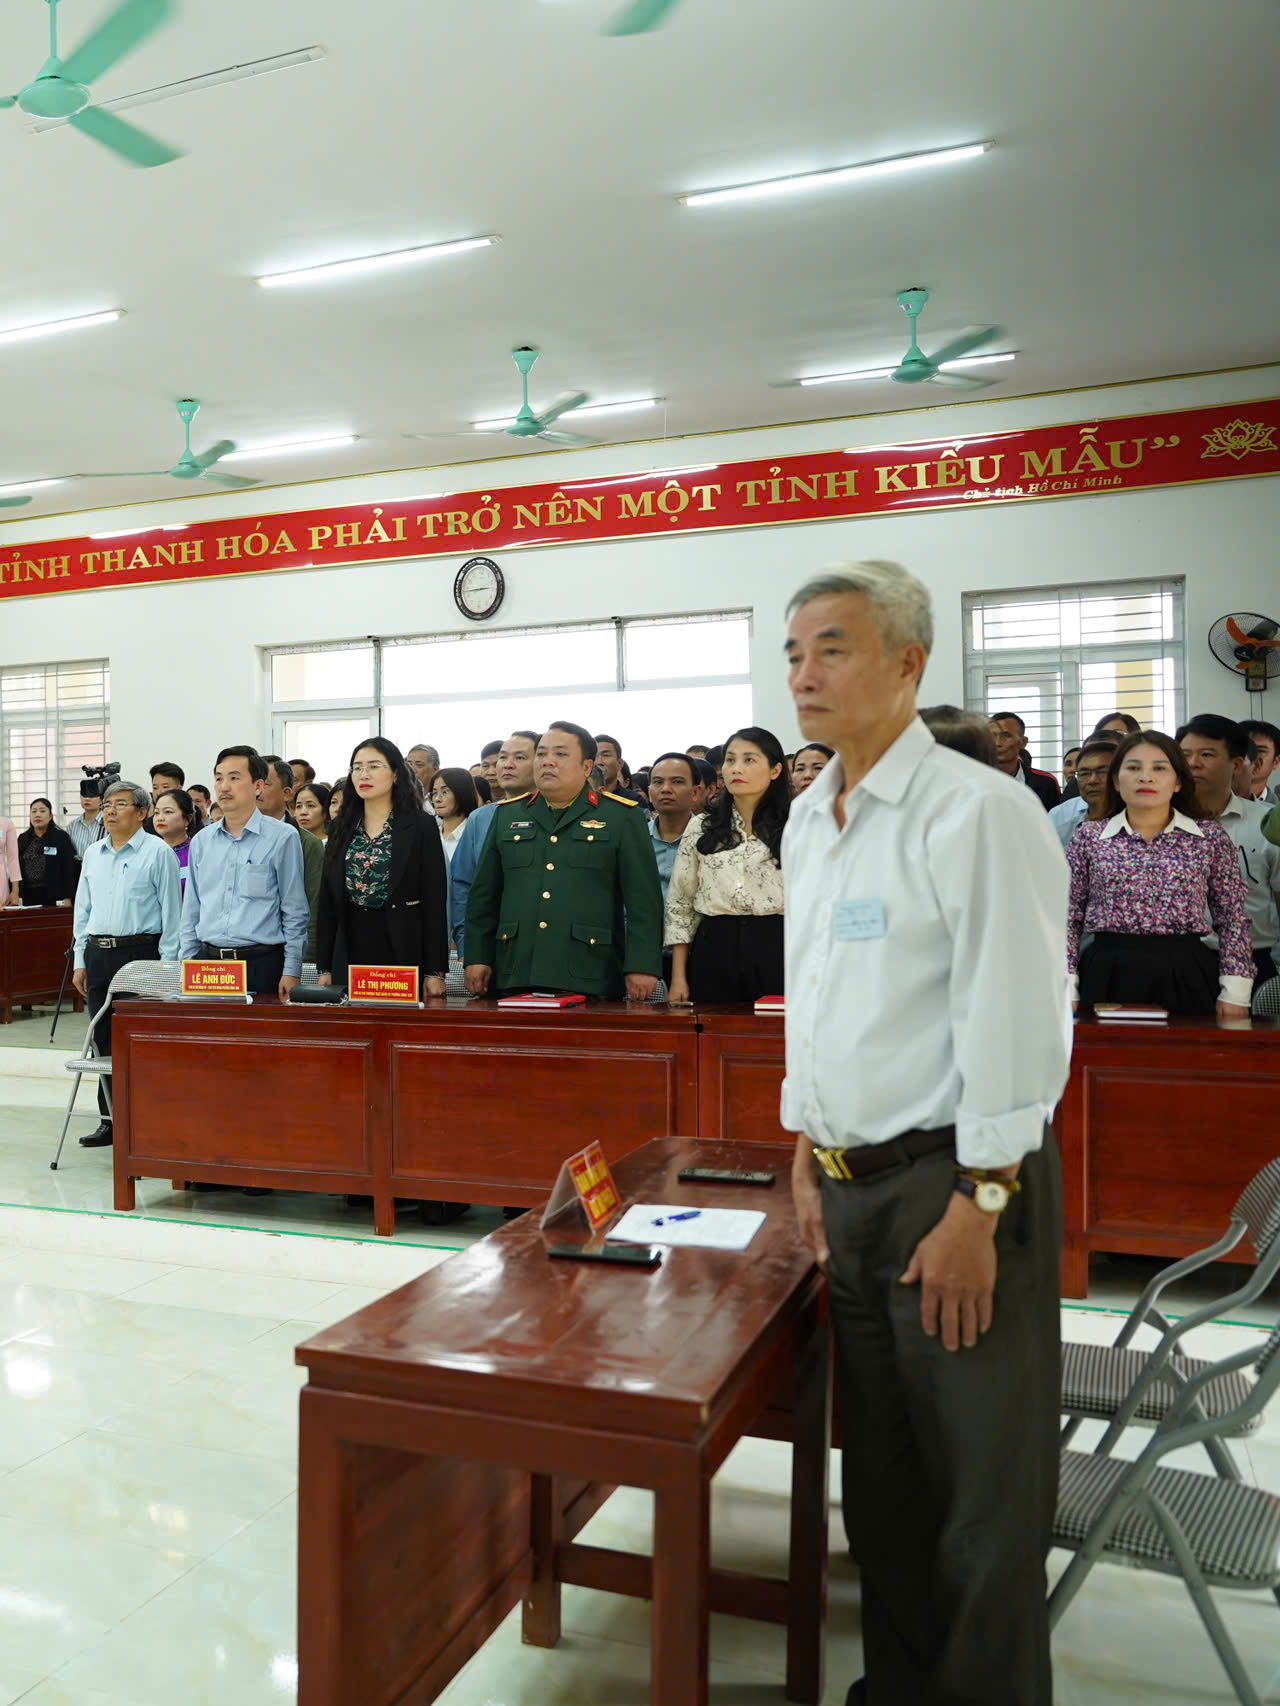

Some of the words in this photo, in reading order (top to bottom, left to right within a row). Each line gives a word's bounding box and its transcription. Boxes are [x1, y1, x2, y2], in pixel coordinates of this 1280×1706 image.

[1027, 479, 1049, 494] Hồ
[1051, 480, 1078, 491] Chí
[1083, 475, 1122, 488] Minh
[79, 540, 204, 575] THANH
[215, 521, 297, 560] HÓA
[308, 508, 408, 551] PHẢI
[417, 495, 502, 538] TRỞ
[512, 492, 605, 530] NÊN
[618, 479, 722, 523] MỘT
[736, 466, 860, 503] TỈNH
[874, 441, 1007, 494] KIỂU
[1020, 427, 1181, 479] MẪU”
[192, 972, 201, 984] LÊ
[203, 974, 218, 984] ANH
[220, 972, 236, 985] ĐỨC
[358, 978, 366, 989] LÊ
[368, 980, 379, 991] THỊ
[380, 980, 408, 991] PHƯƠNG
